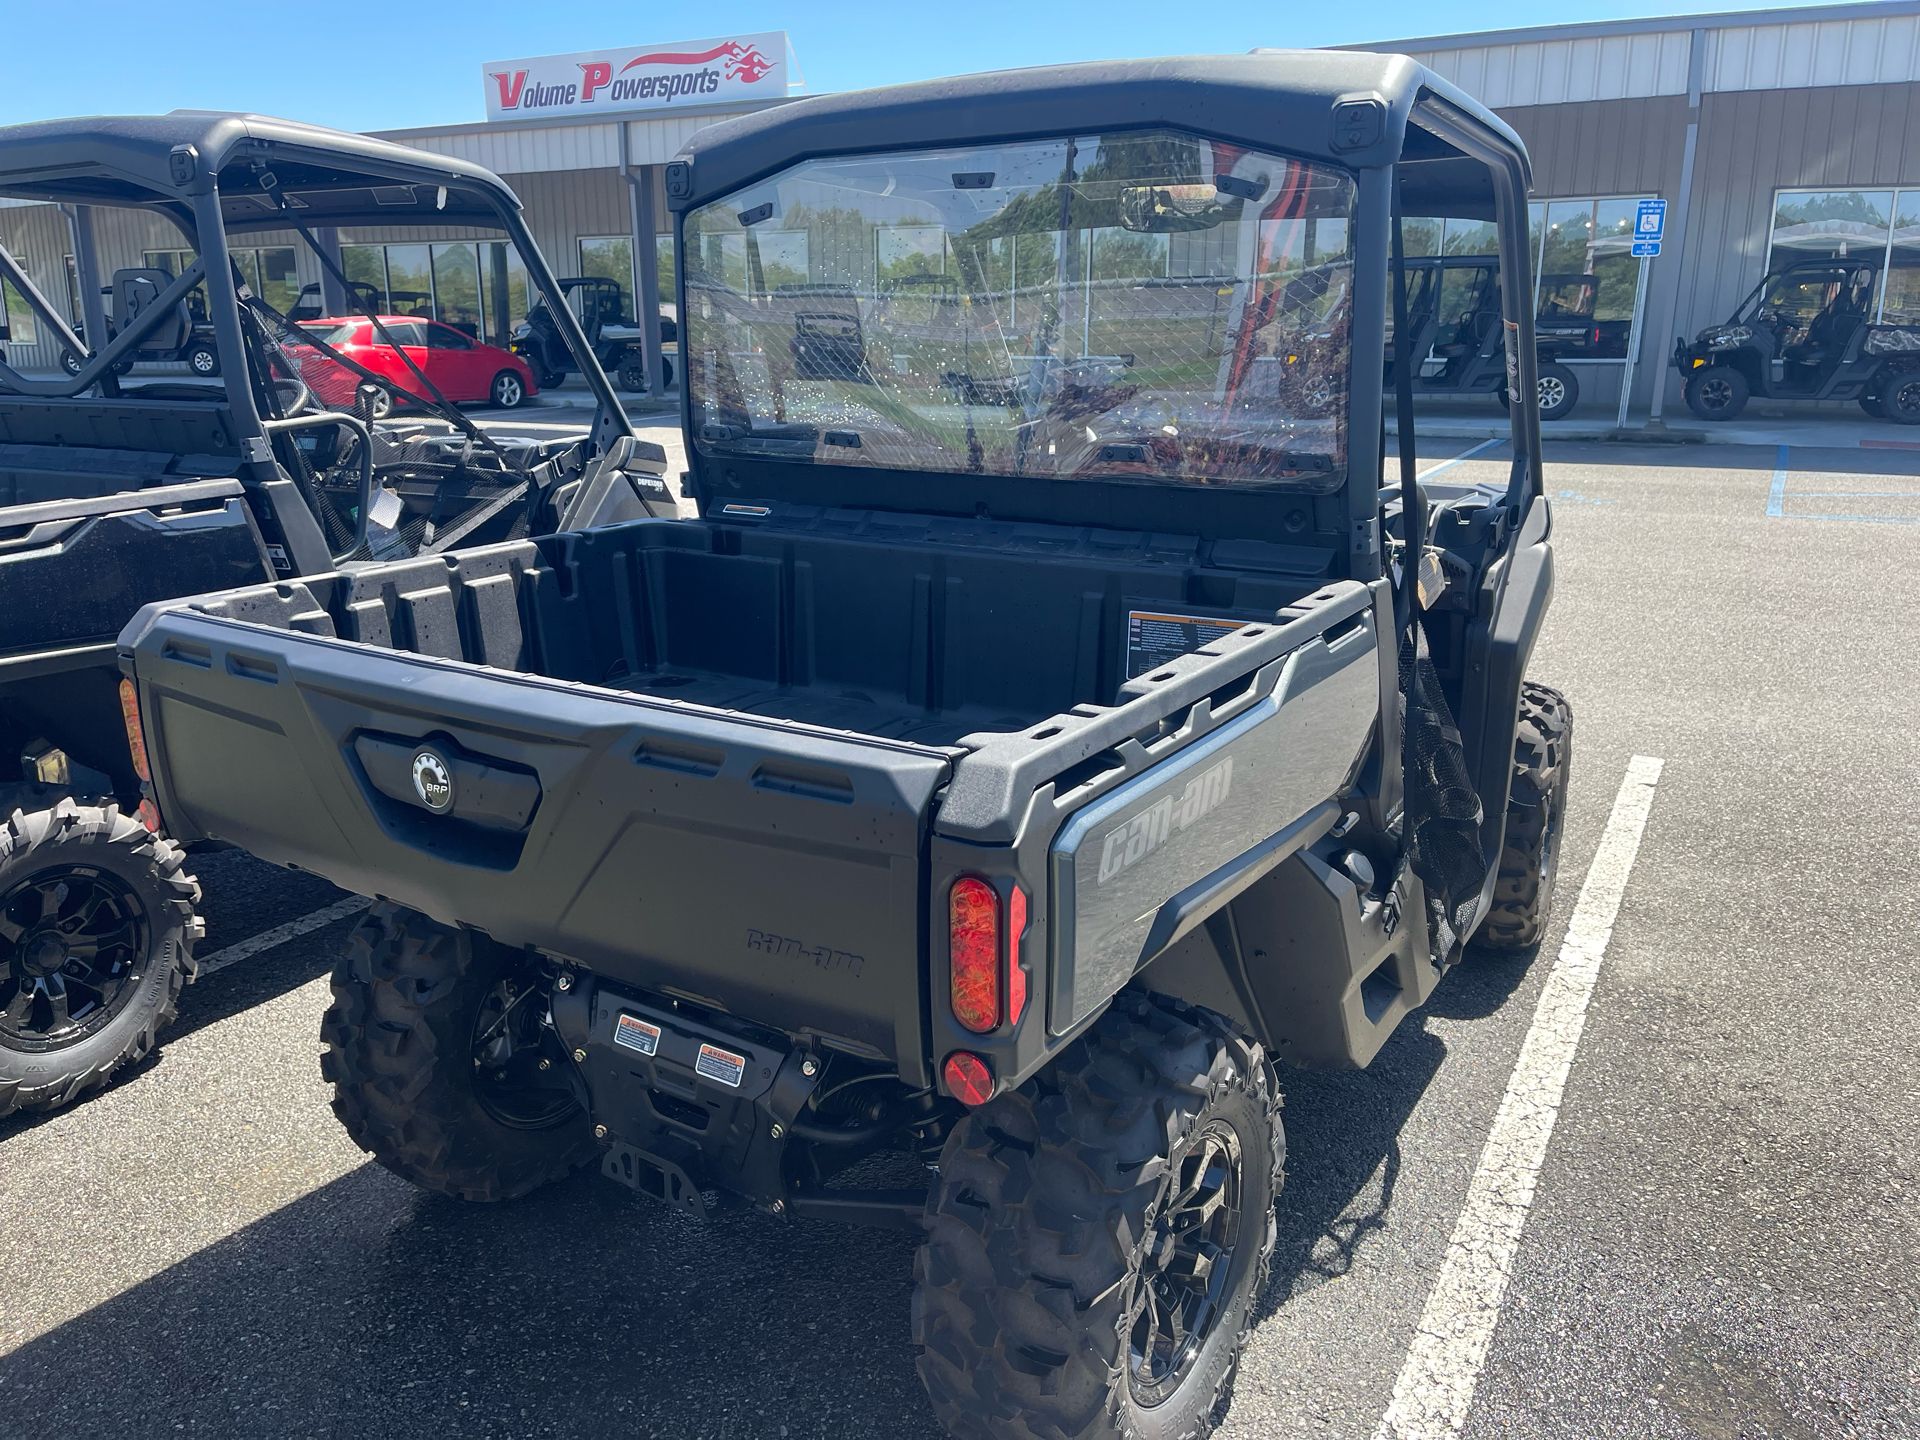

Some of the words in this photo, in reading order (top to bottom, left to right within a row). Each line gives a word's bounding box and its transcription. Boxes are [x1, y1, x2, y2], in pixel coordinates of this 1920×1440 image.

[488, 69, 577, 110] Volume
[576, 61, 719, 103] Powersports
[426, 783, 448, 794] BRP
[630, 1021, 653, 1034] WARNING
[713, 1050, 737, 1063] WARNING
